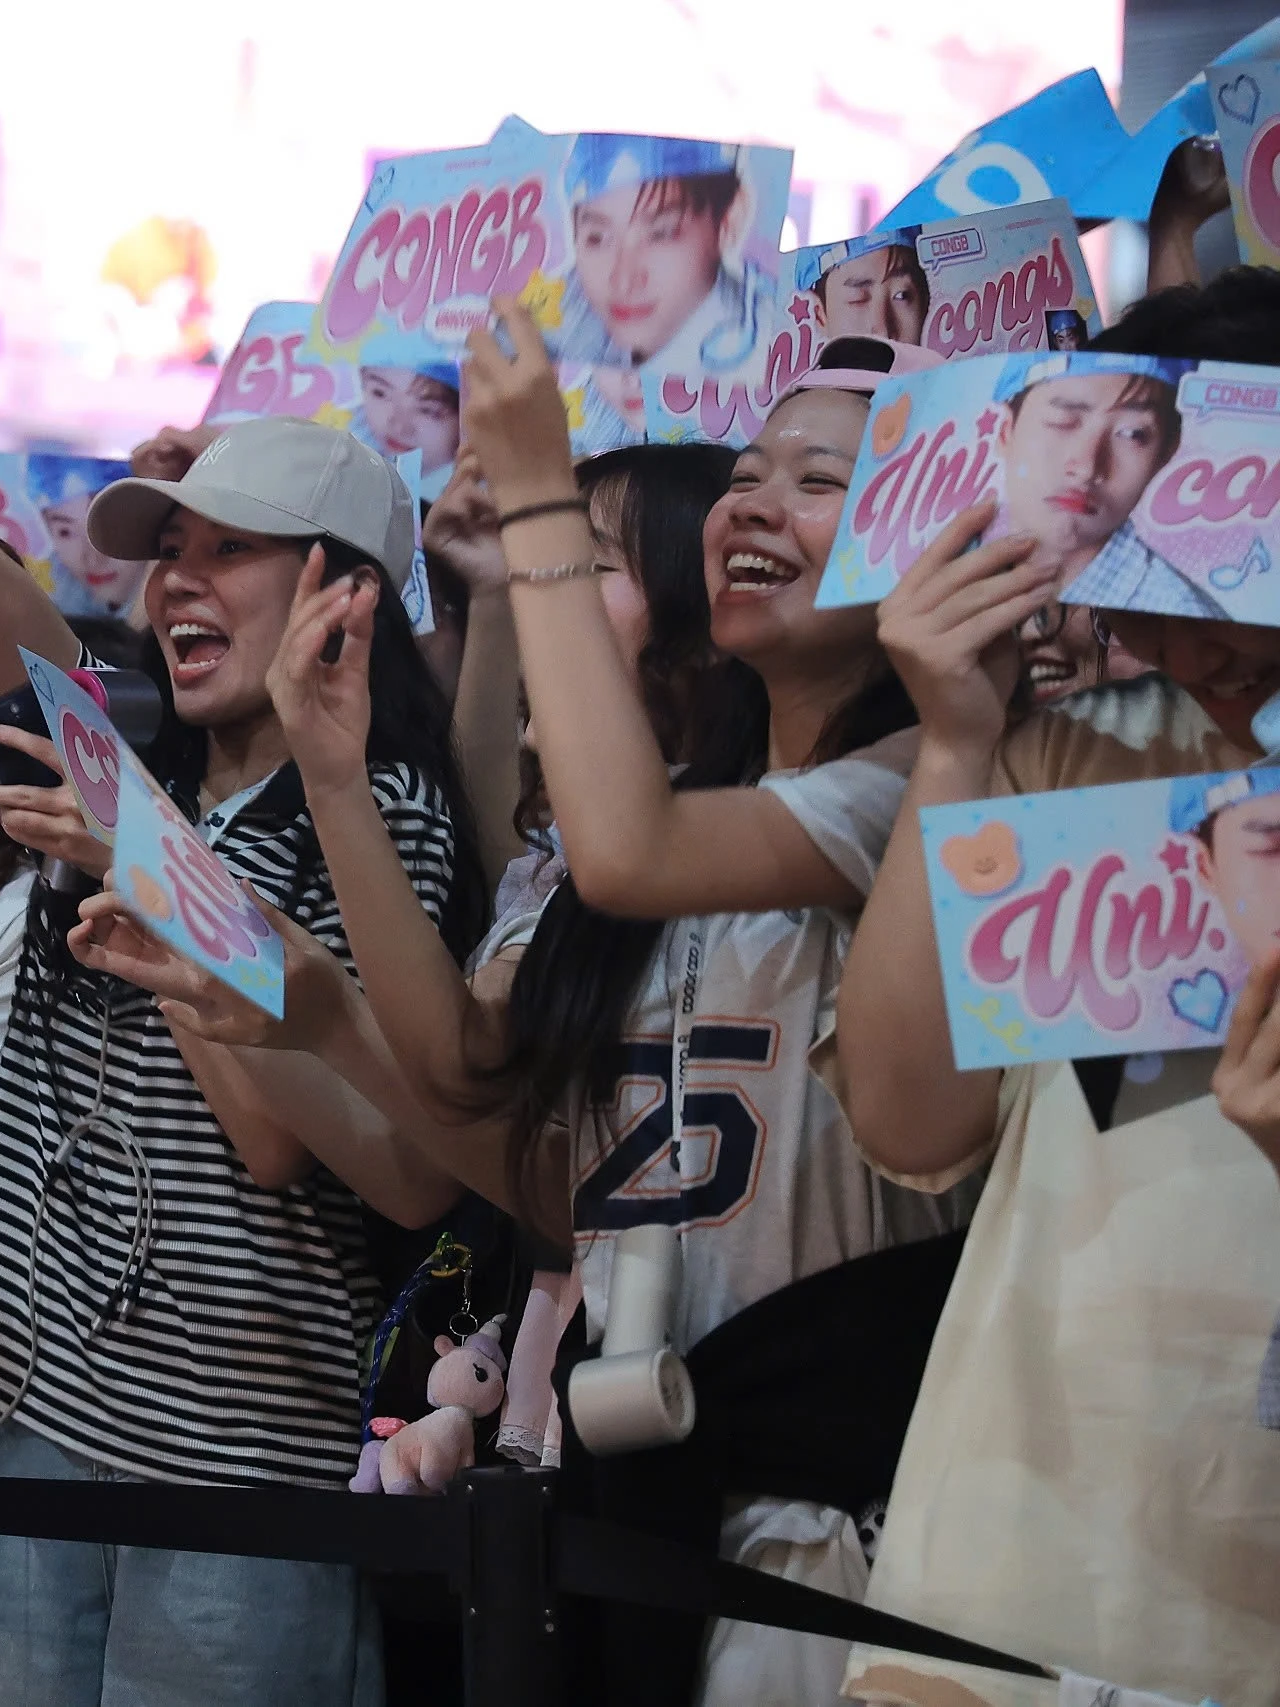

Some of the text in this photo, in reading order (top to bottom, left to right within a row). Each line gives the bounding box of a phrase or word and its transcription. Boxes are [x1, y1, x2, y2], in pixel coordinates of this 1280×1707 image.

[326, 180, 546, 338] CONGB
[927, 237, 1073, 359] congs
[931, 234, 969, 257] CONGB
